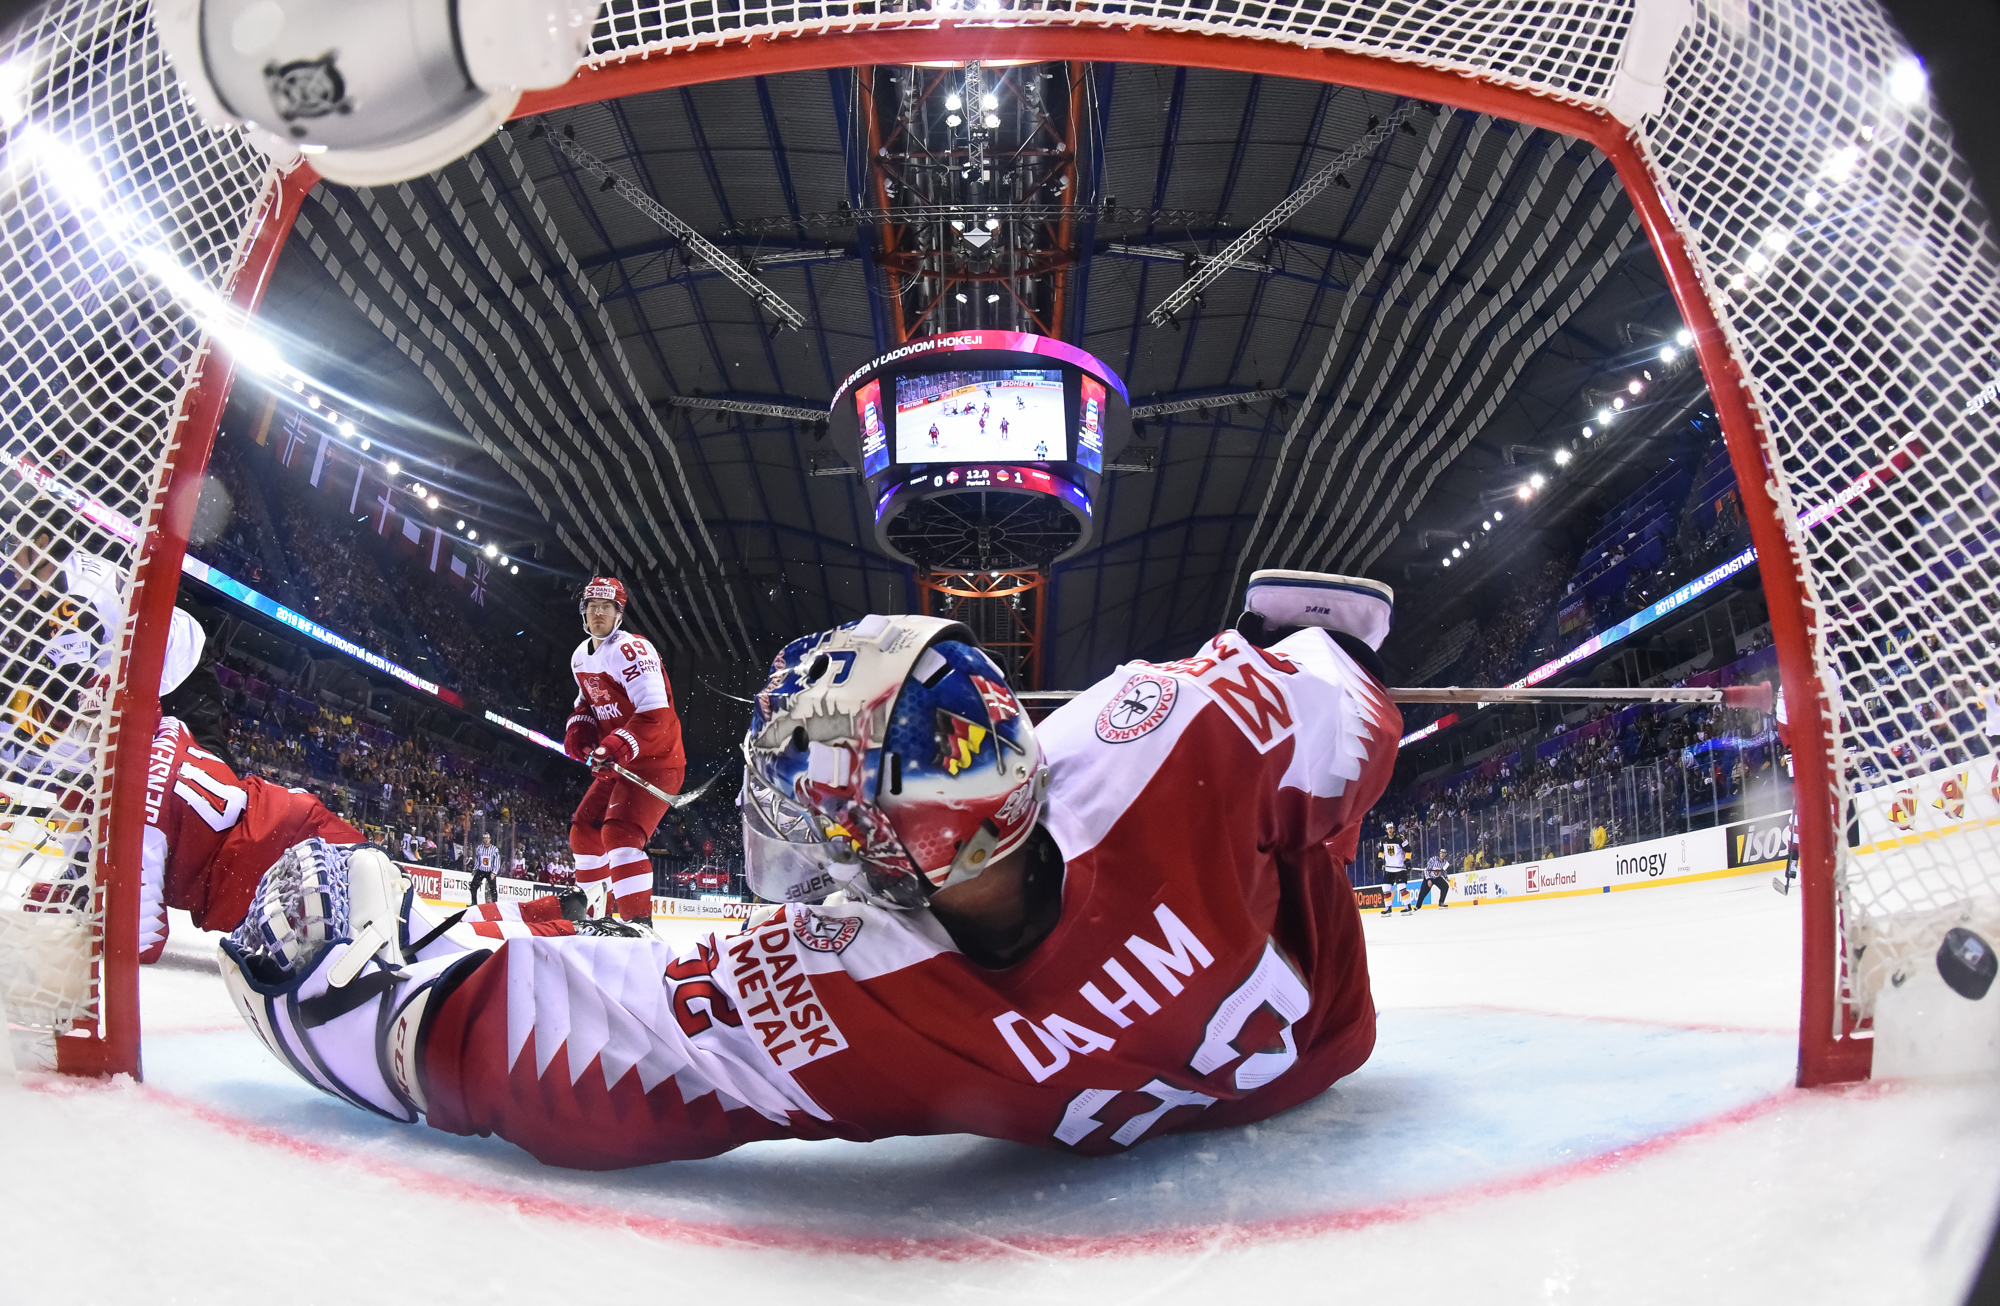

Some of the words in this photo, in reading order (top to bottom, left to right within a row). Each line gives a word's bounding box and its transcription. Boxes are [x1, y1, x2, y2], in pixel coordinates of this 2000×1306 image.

[848, 363, 871, 385] SVETA
[872, 358, 880, 369] V
[937, 335, 982, 348] HOKEJI
[933, 475, 943, 487] 0
[966, 469, 990, 480] 12.0
[1014, 472, 1023, 483] 1
[1304, 605, 1331, 615] DAHM
[1655, 596, 1676, 616] 2019
[276, 606, 298, 626] 2019
[620, 640, 648, 662] 89
[145, 736, 178, 825] JENSEN
[1616, 852, 1667, 877] innogy
[455, 879, 484, 892] TISST
[1540, 870, 1577, 888] Kaufland
[508, 885, 532, 897] TISSOT
[1358, 890, 1383, 908] Orange
[1464, 883, 1488, 896] KOŠICE
[728, 938, 797, 1066] METAL
[759, 928, 838, 1057] DANSK
[992, 902, 1215, 1084] DAHM
